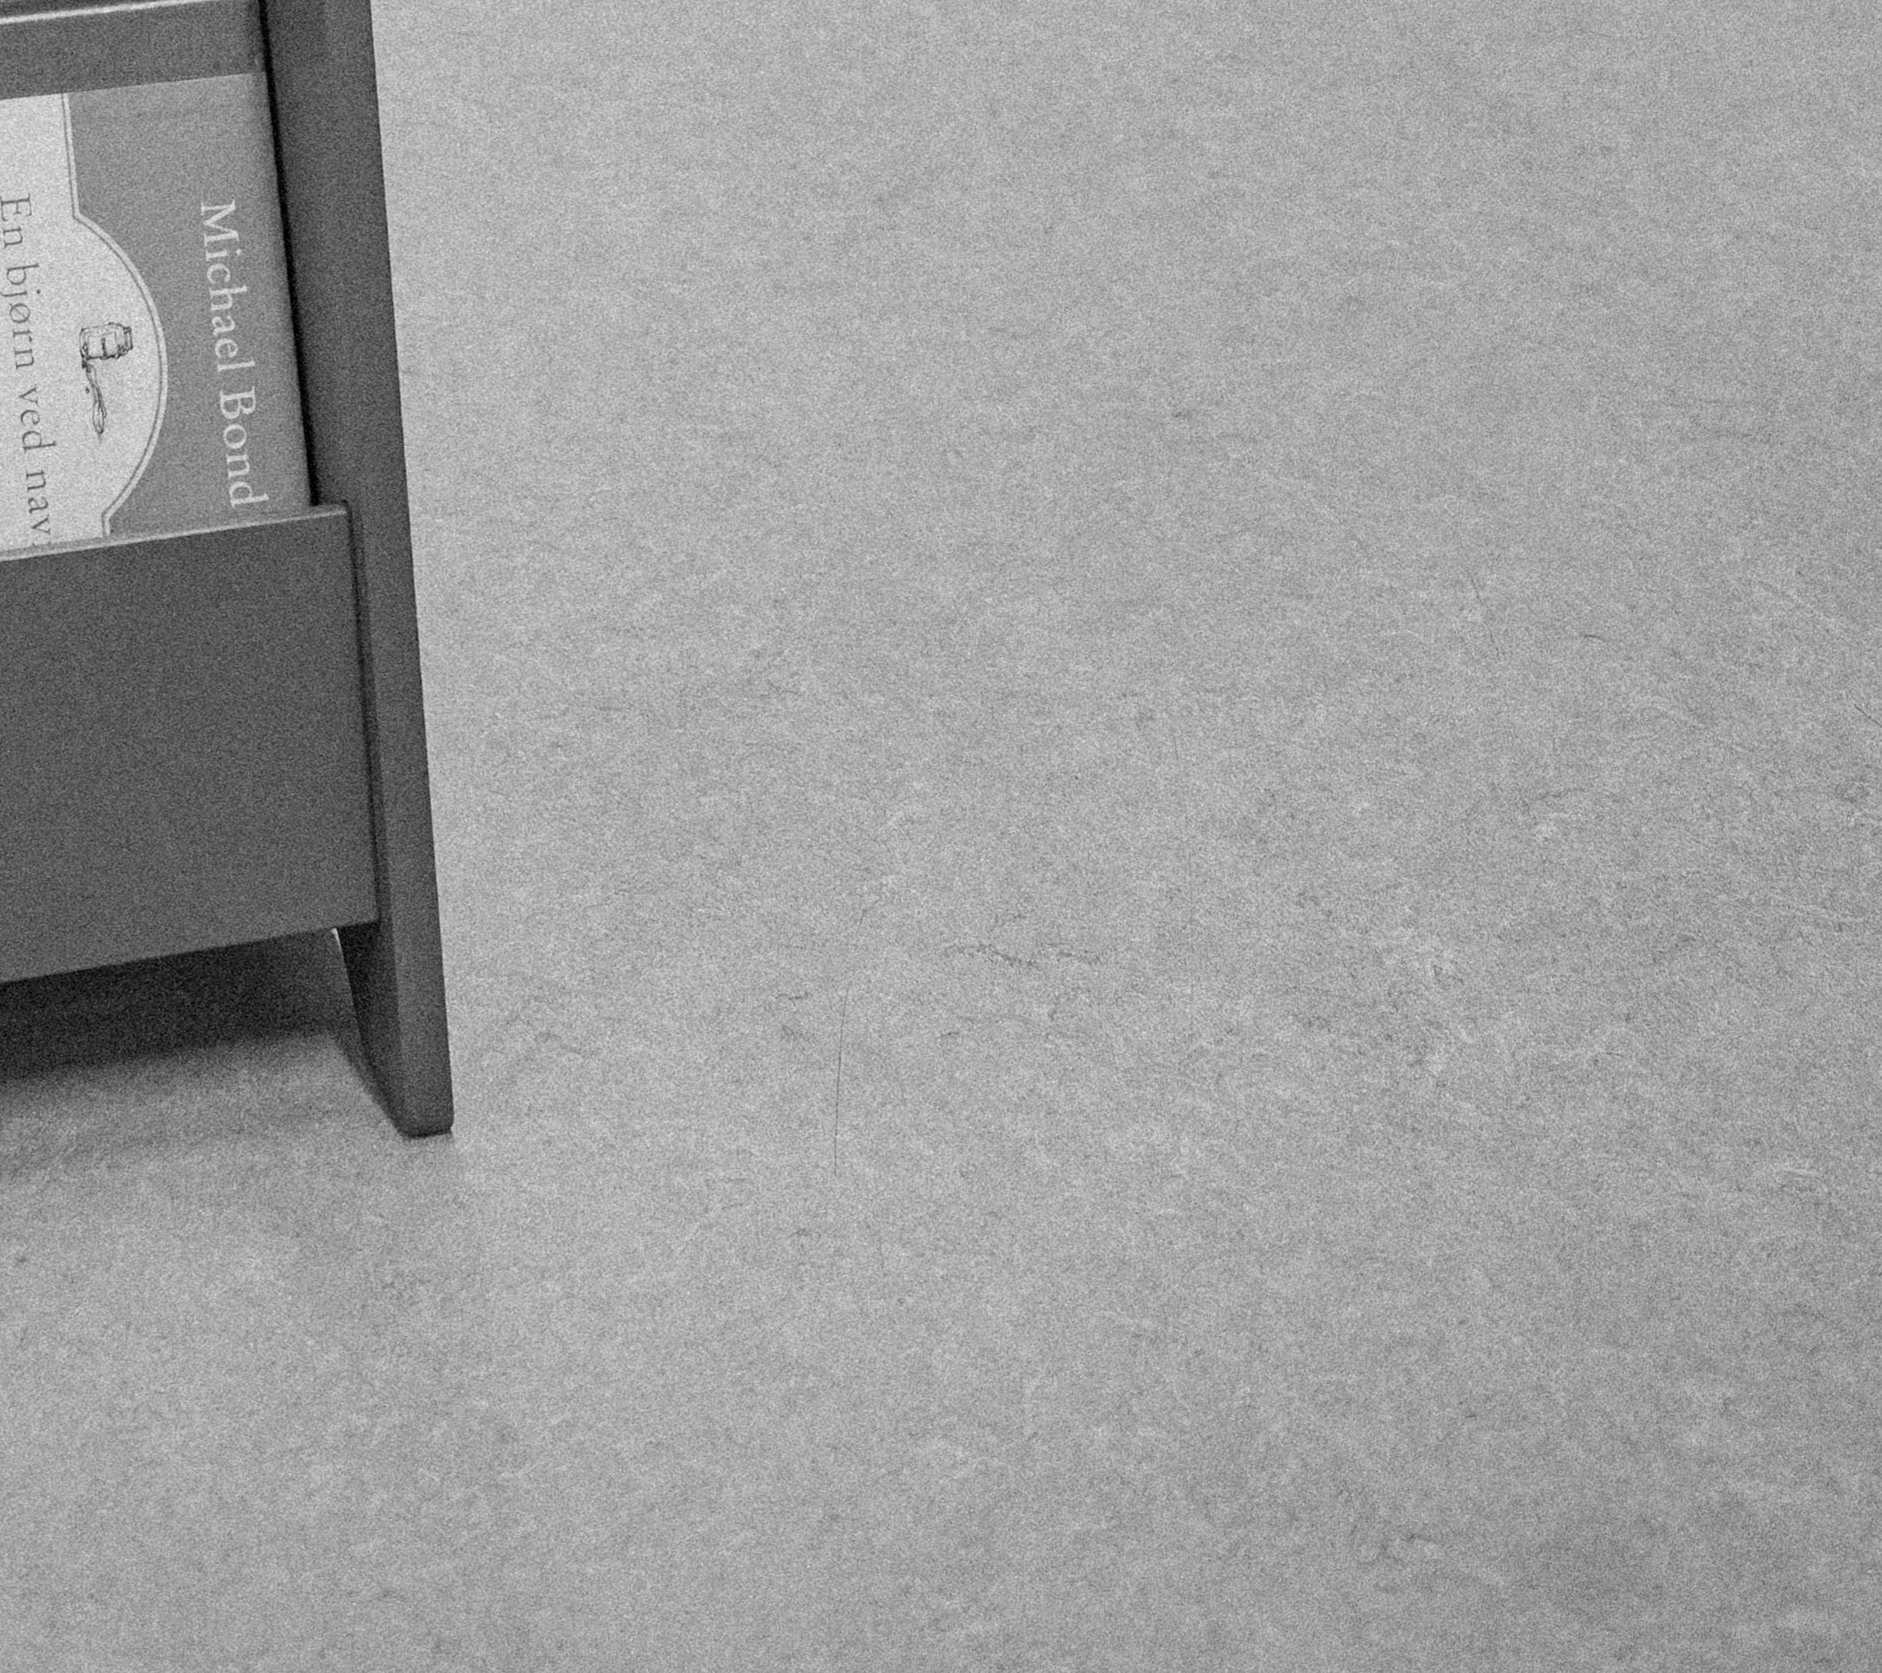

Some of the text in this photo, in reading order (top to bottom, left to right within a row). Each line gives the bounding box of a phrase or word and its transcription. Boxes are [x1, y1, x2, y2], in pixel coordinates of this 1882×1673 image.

[199, 199, 269, 509] Michael Bond
[18, 386, 56, 453] ved
[23, 468, 55, 547] nav
